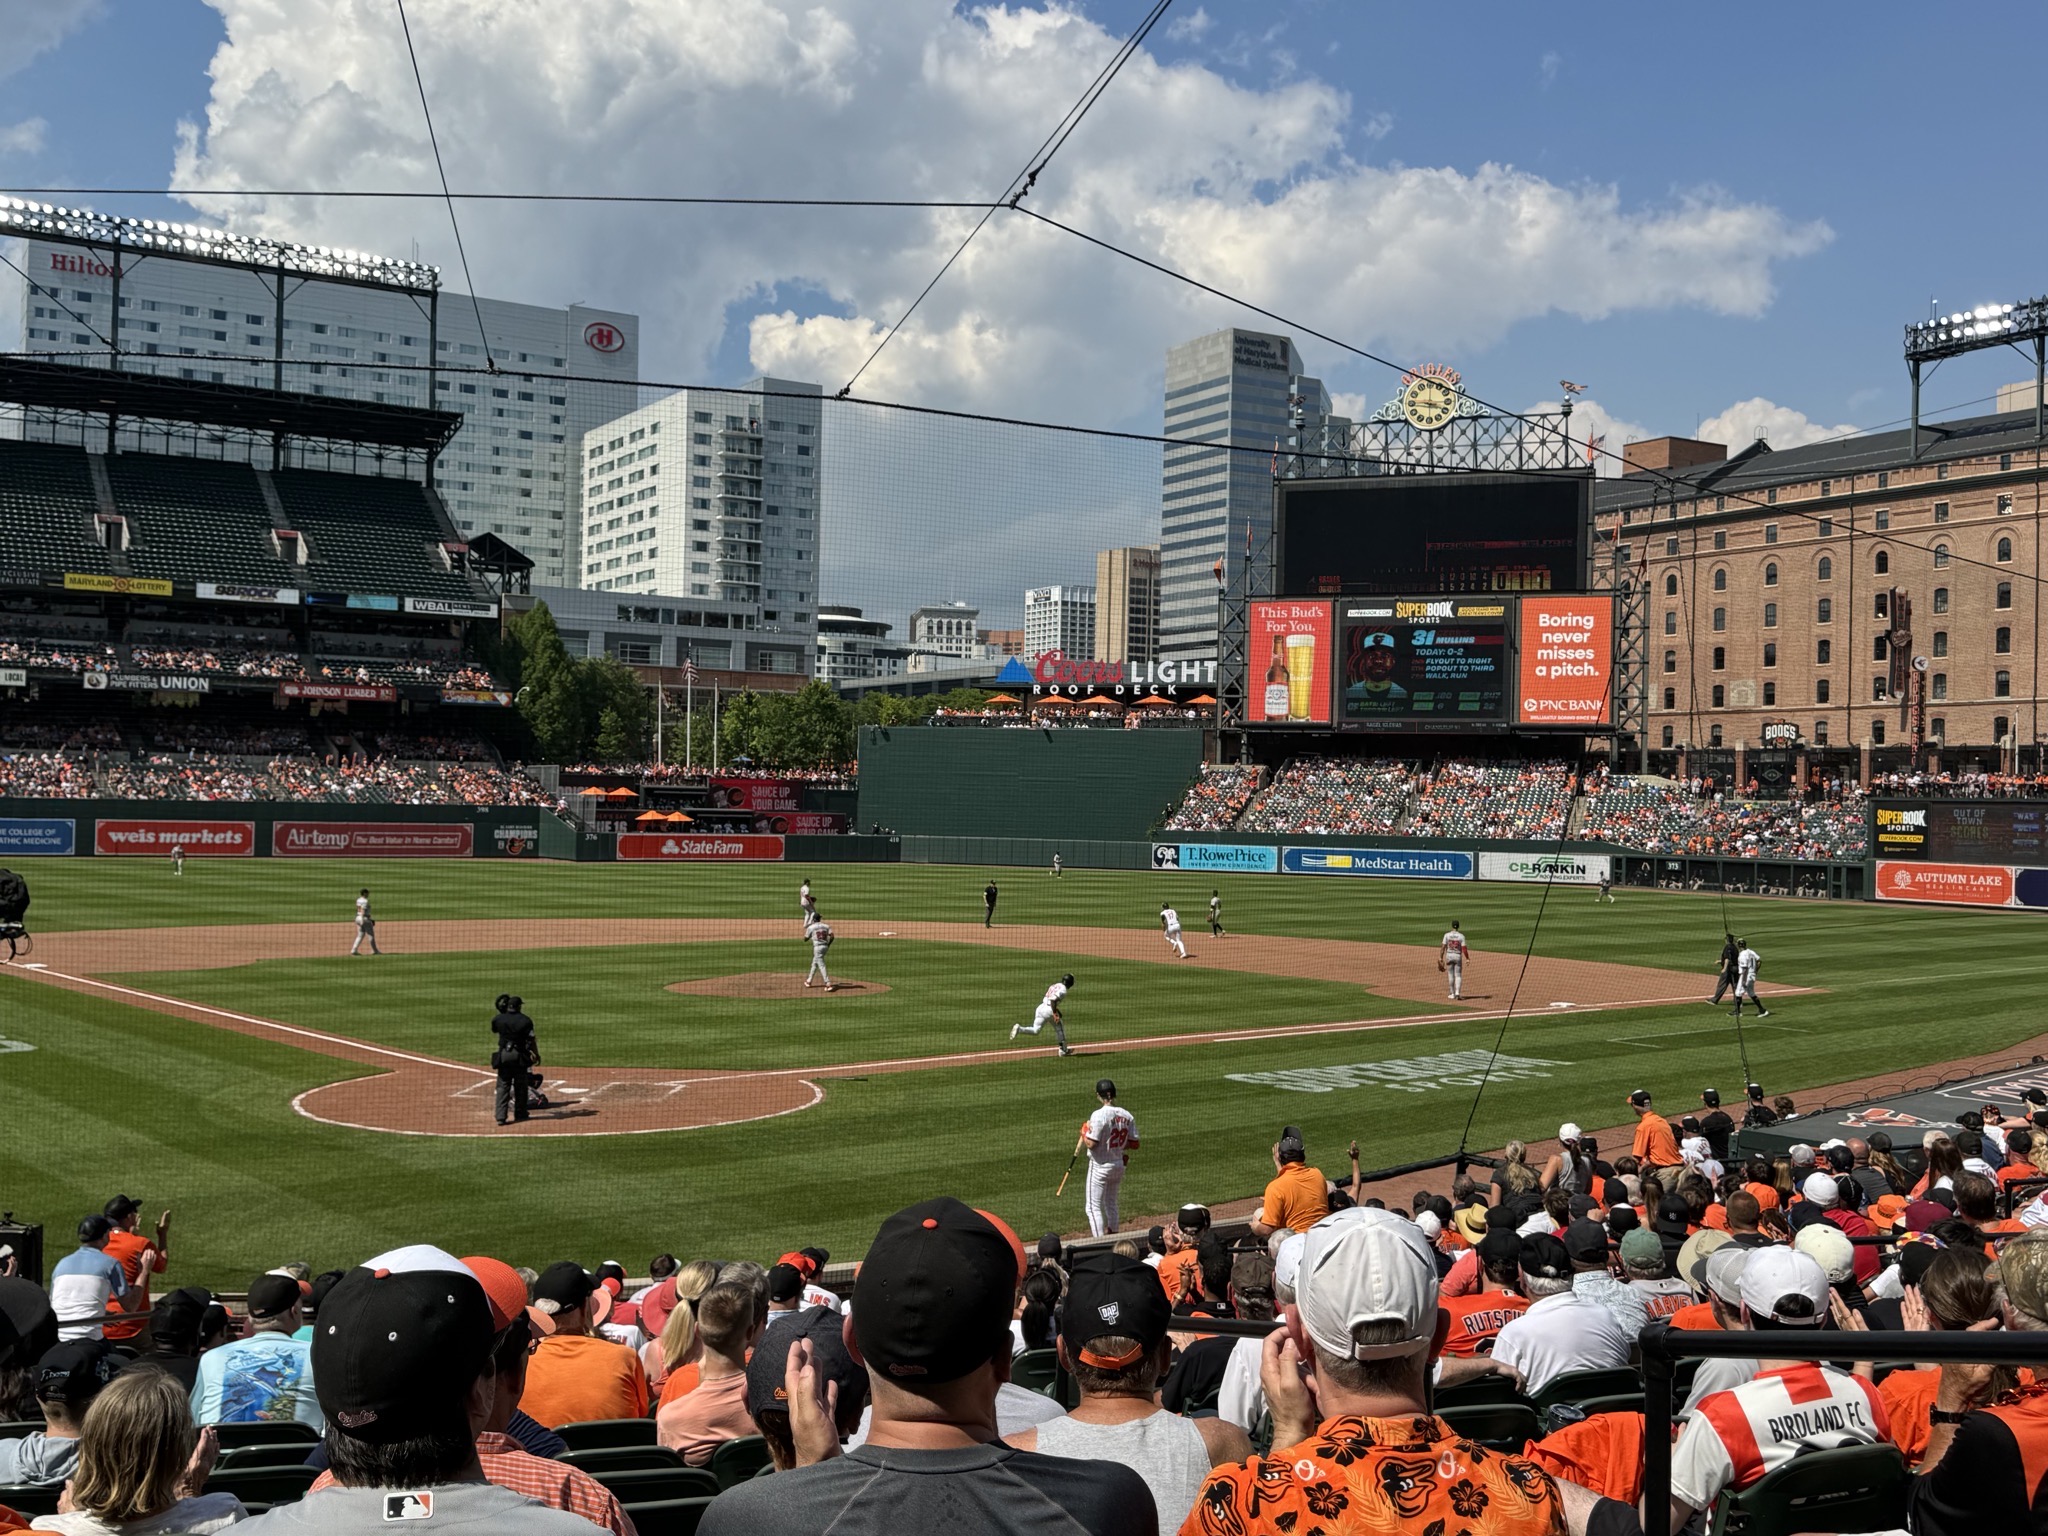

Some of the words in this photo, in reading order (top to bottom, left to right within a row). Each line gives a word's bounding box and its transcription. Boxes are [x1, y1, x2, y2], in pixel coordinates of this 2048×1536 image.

[1234, 335, 1271, 349] University
[1234, 347, 1244, 357] of
[1244, 347, 1276, 361] Maryland
[1234, 355, 1262, 368] Medical
[1263, 360, 1288, 372] System
[69, 576, 113, 588] MARYLAND
[131, 582, 167, 591] LOTTERY
[414, 600, 452, 613] WBAL
[1259, 606, 1287, 618] This
[1291, 606, 1323, 618] Bud's
[1396, 601, 1454, 619] SUPERBOOK
[1266, 620, 1286, 632] For
[1288, 620, 1315, 632] You.
[1538, 612, 1594, 629] Boring
[1411, 629, 1436, 646] 31
[1436, 636, 1475, 644] MULLINS
[1542, 631, 1591, 643] never
[1415, 648, 1446, 656] TODAY:
[1447, 647, 1464, 656] 0-2
[1537, 645, 1595, 660] misses
[1034, 648, 1124, 684] Coors
[1130, 660, 1217, 683] LIGHT
[1535, 665, 1547, 677] a
[1551, 662, 1599, 679] pitch.
[110, 674, 151, 682] PLUMBERS
[160, 676, 209, 690] UNION
[129, 681, 159, 689] FITTERS
[1033, 684, 1094, 695] ROOF
[1115, 684, 1176, 695] DECK
[302, 686, 341, 697] JOHNSON
[344, 688, 376, 698] LUMBER
[1540, 700, 1568, 711] PNC
[1569, 700, 1605, 711] BANK
[751, 786, 778, 798] SAUCE
[779, 787, 790, 798] UP
[752, 798, 773, 810] YOUR
[774, 799, 799, 811] GAME.
[1877, 809, 1927, 827] SUPERBOOK
[1953, 809, 1971, 817] OUT
[1974, 809, 1986, 817] OF
[796, 816, 821, 827] SAUCE
[822, 817, 833, 827] UP
[1956, 816, 1983, 825] TOWN
[8, 828, 43, 836] COLLEGE
[44, 828, 56, 836] OF
[108, 829, 156, 844] weis
[158, 830, 243, 844] markets
[287, 828, 349, 848] Airtemp
[494, 829, 538, 839] CHAMPIONS
[585, 833, 598, 841] 376
[23, 837, 61, 845] MEDICINE
[355, 836, 367, 844] The
[368, 836, 384, 844] Best
[433, 836, 458, 845] Comfort
[1354, 857, 1407, 869] MedStar
[1409, 858, 1453, 872] Health
[1532, 863, 1586, 874] RANKIN
[1915, 872, 1967, 884] AUTUMN
[1969, 875, 2002, 886] LAKE
[1101, 1304, 1117, 1318] DAP
[1645, 1295, 1693, 1318] ARVE
[1767, 1405, 1845, 1443] BIRDLAND
[1845, 1401, 1866, 1428] FC
